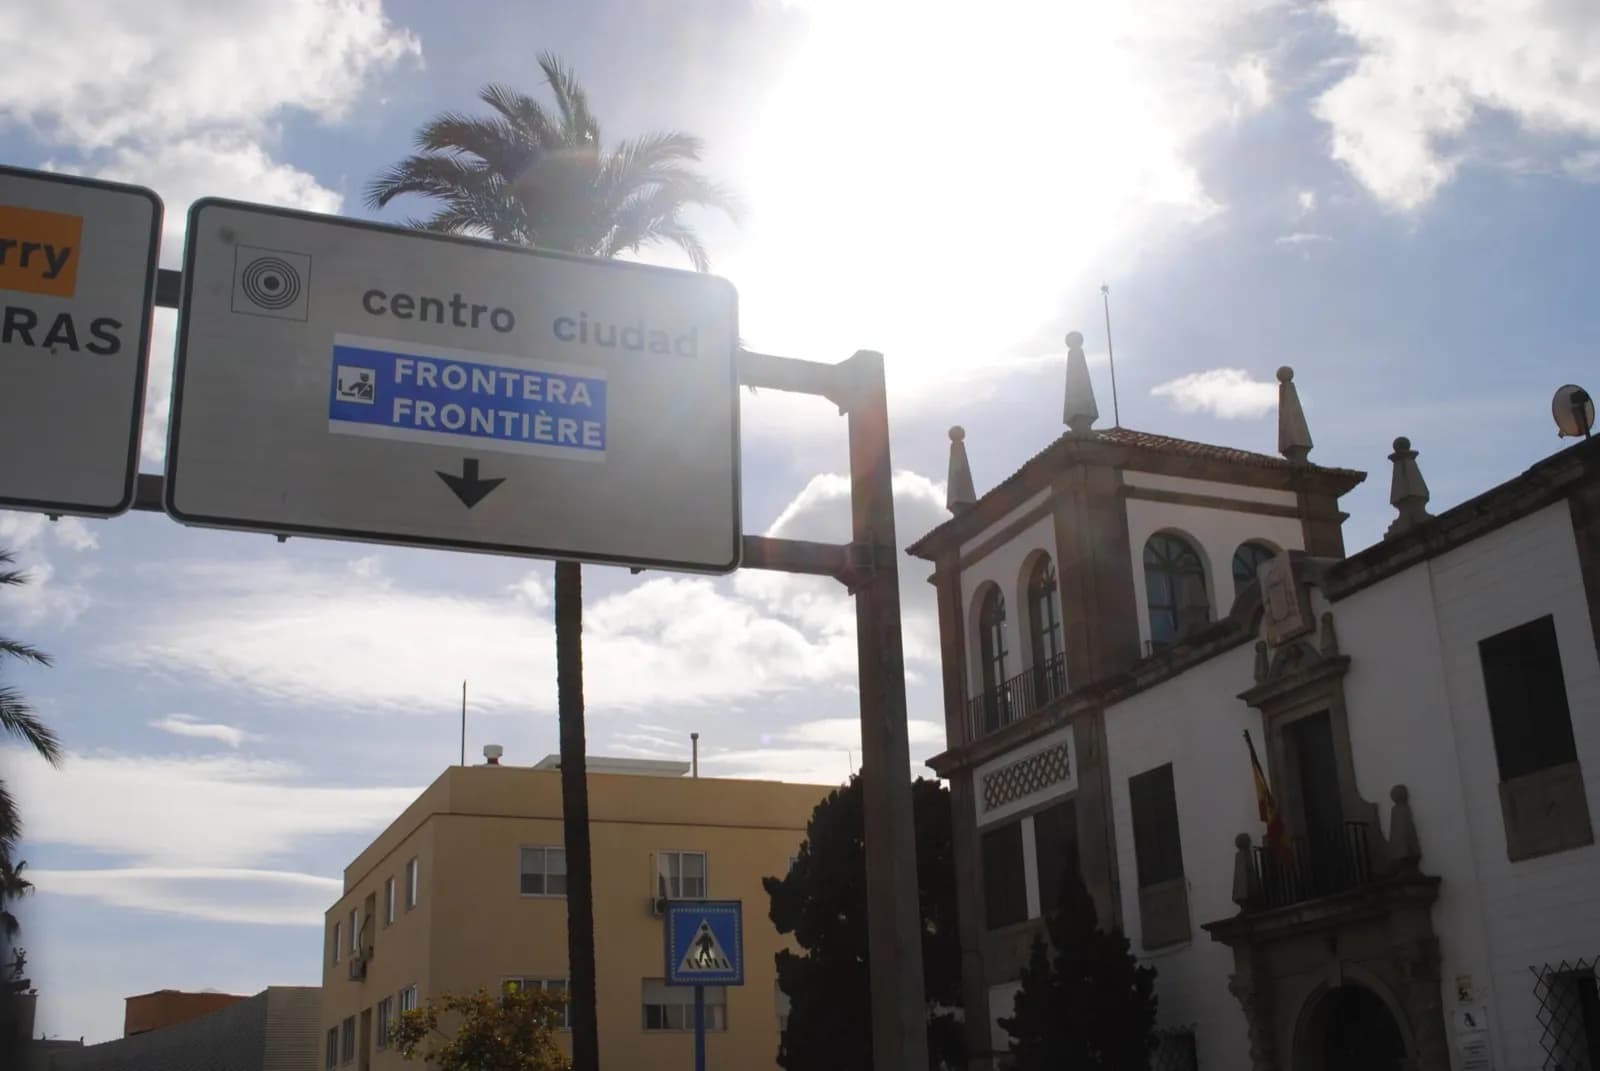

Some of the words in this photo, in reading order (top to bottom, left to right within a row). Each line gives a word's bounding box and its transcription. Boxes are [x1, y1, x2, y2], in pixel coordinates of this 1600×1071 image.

[1, 305, 123, 356] RAS
[362, 288, 516, 334] centro
[553, 311, 699, 358] ciudad
[393, 358, 593, 407] FRONTERA
[391, 397, 603, 447] FRONTIÈRE
